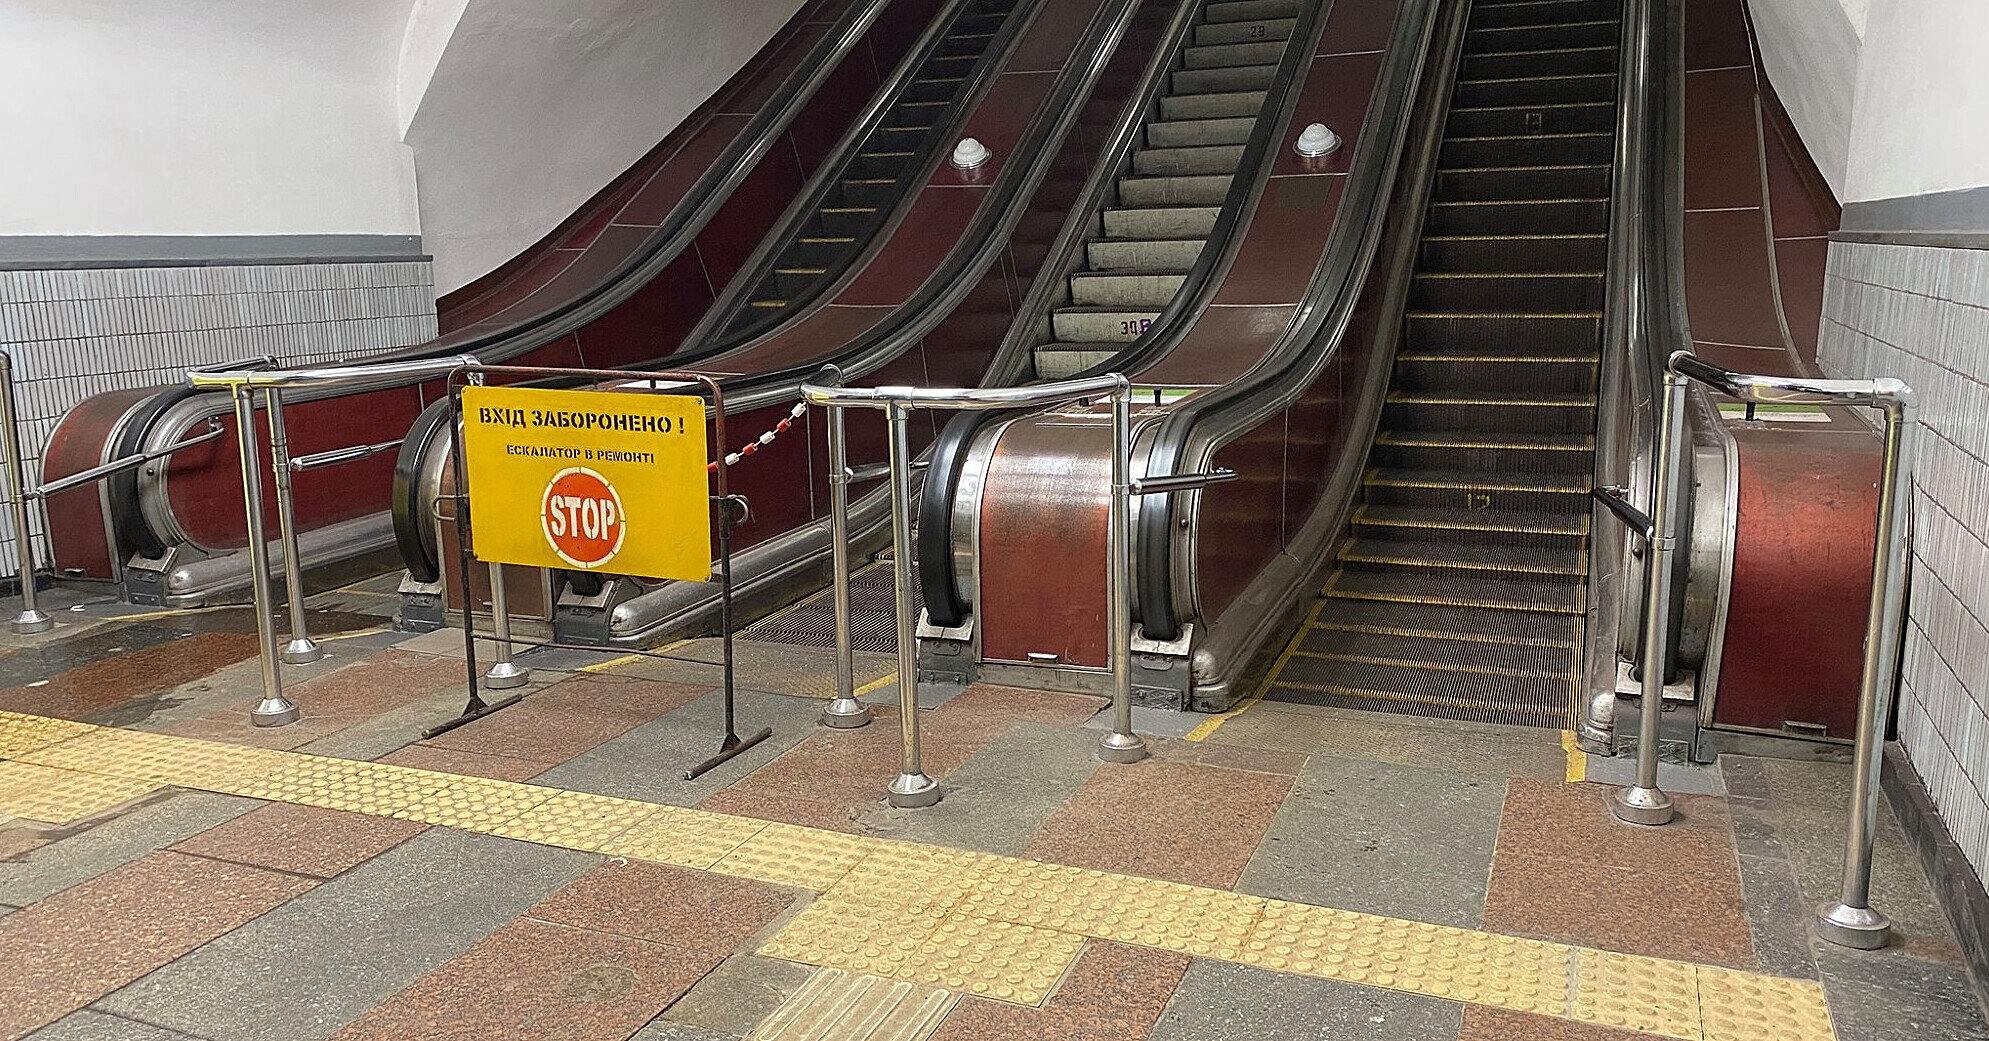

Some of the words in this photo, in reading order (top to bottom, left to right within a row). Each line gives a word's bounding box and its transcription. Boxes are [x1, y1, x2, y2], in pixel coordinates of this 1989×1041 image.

[480, 407, 527, 428] ВХІД
[531, 409, 672, 434] ЗАБОРОНЕНО
[679, 417, 685, 434] !
[506, 444, 581, 461] ЕСКАЛАТОР
[585, 450, 593, 460] В
[597, 450, 655, 464] РЕМОНТІ
[550, 494, 617, 541] STOP
